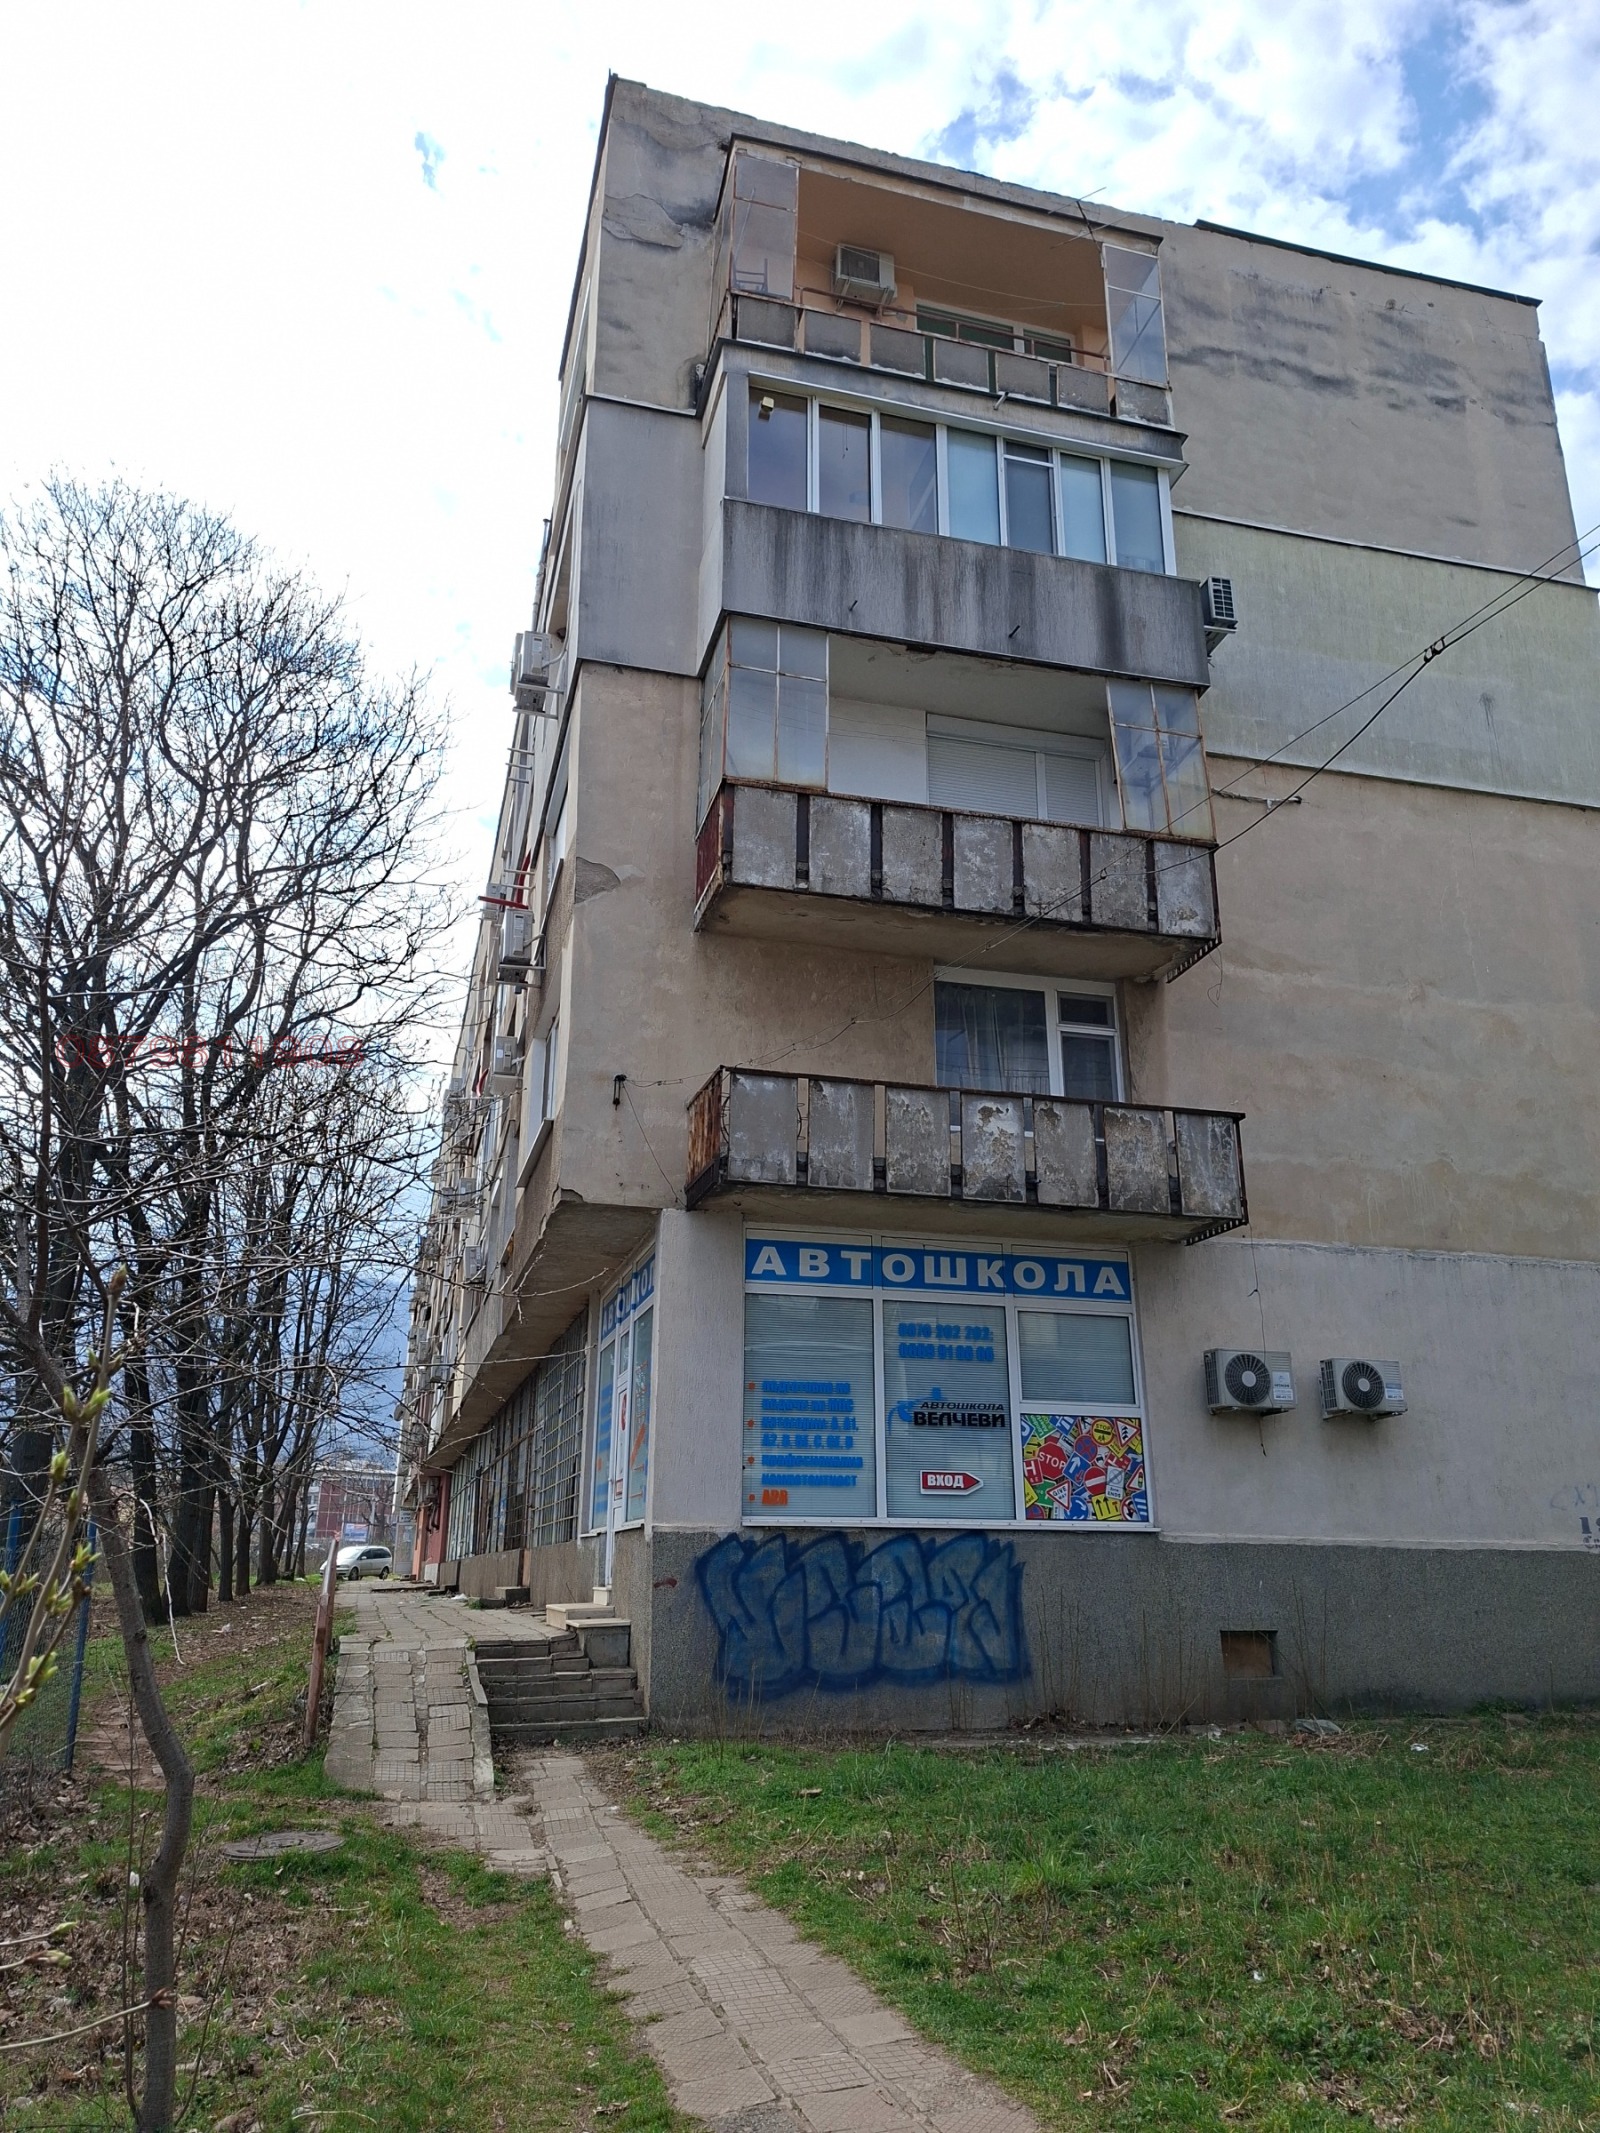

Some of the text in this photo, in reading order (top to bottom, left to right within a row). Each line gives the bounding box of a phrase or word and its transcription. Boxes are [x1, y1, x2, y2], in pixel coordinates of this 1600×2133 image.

[751, 1246, 1126, 1296] АВТОШКОЛА
[920, 1401, 1005, 1410] АВТОШКОЛА
[913, 1411, 1006, 1427] ВЕЛЧЕВИ
[1039, 1451, 1067, 1470] STOP
[927, 1474, 965, 1488] ВХОД
[1052, 1485, 1067, 1496] GIVE
